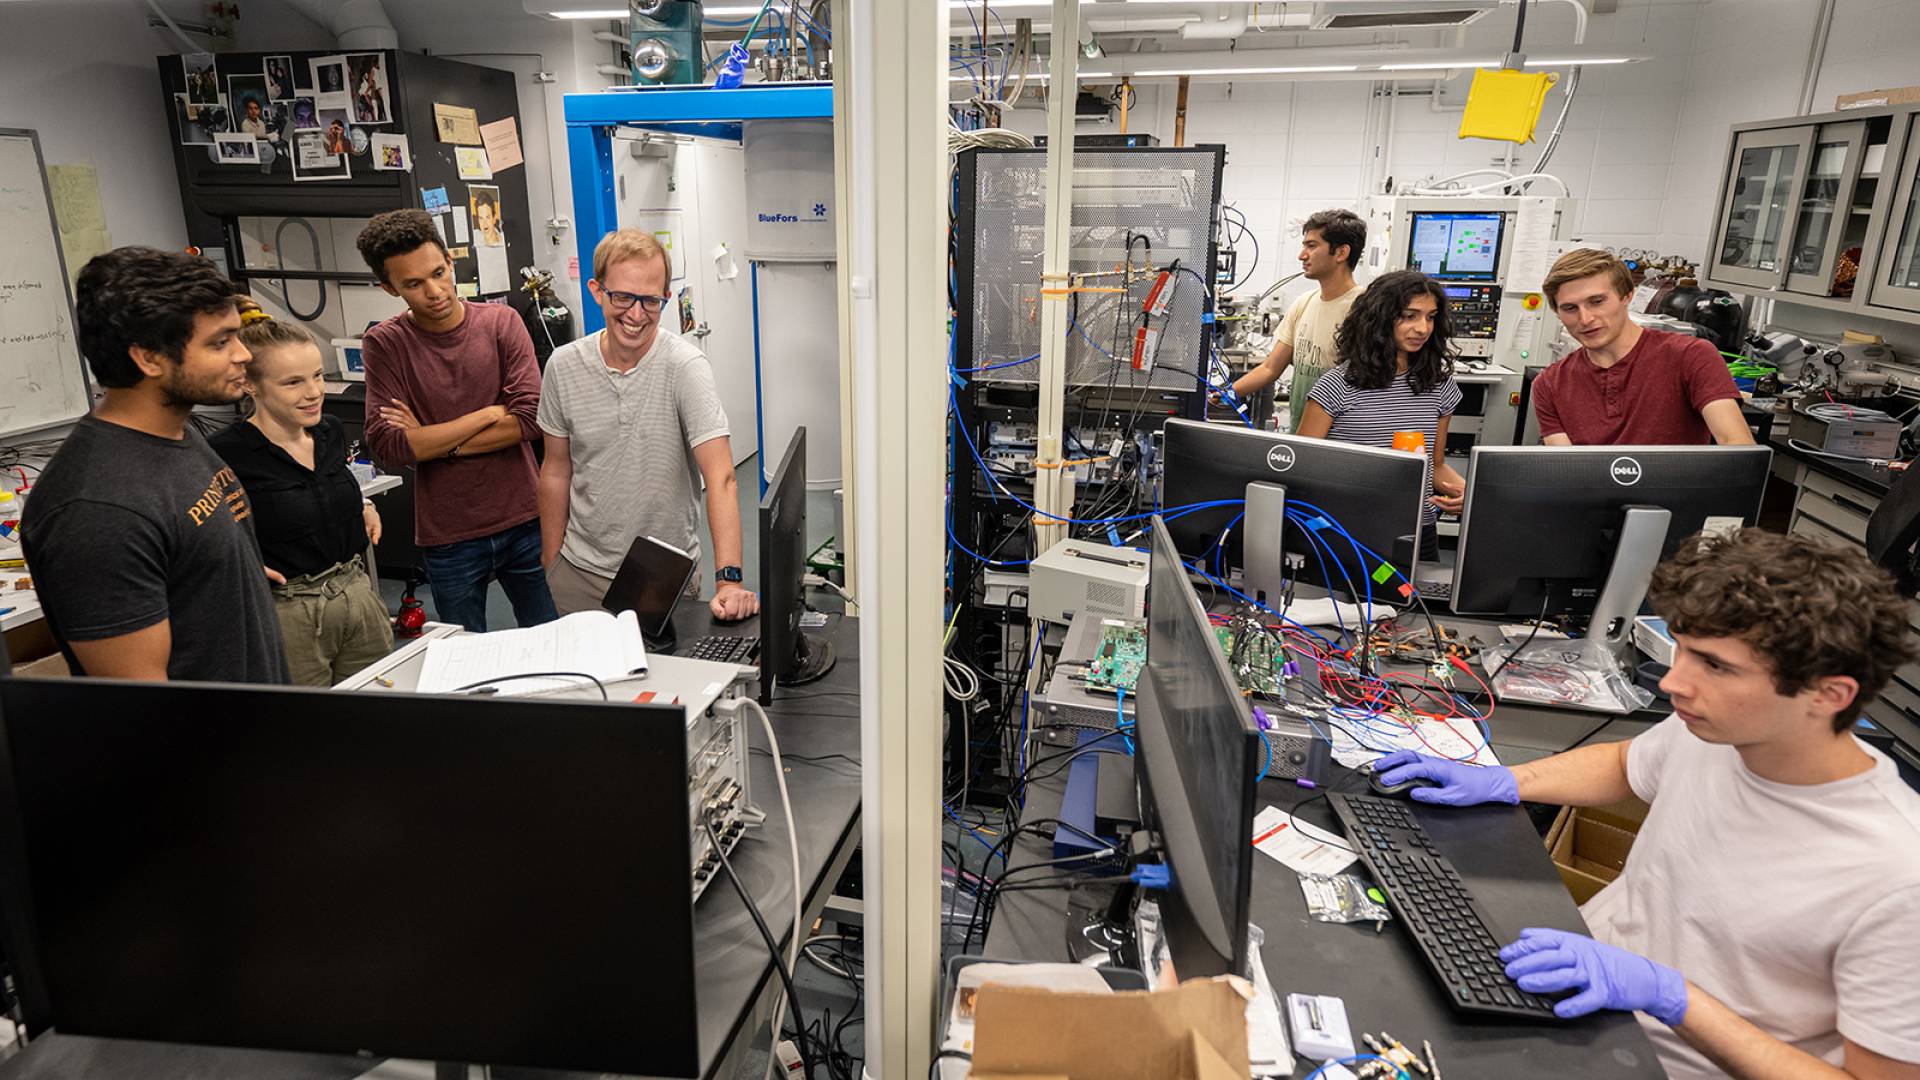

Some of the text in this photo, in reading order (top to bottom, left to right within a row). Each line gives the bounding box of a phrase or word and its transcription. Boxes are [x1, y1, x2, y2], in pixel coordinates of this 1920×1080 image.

[758, 213, 798, 222] BlueFors
[1270, 452, 1291, 463] DELL
[1614, 466, 1638, 475] DELL
[187, 467, 237, 526] PRINTO
